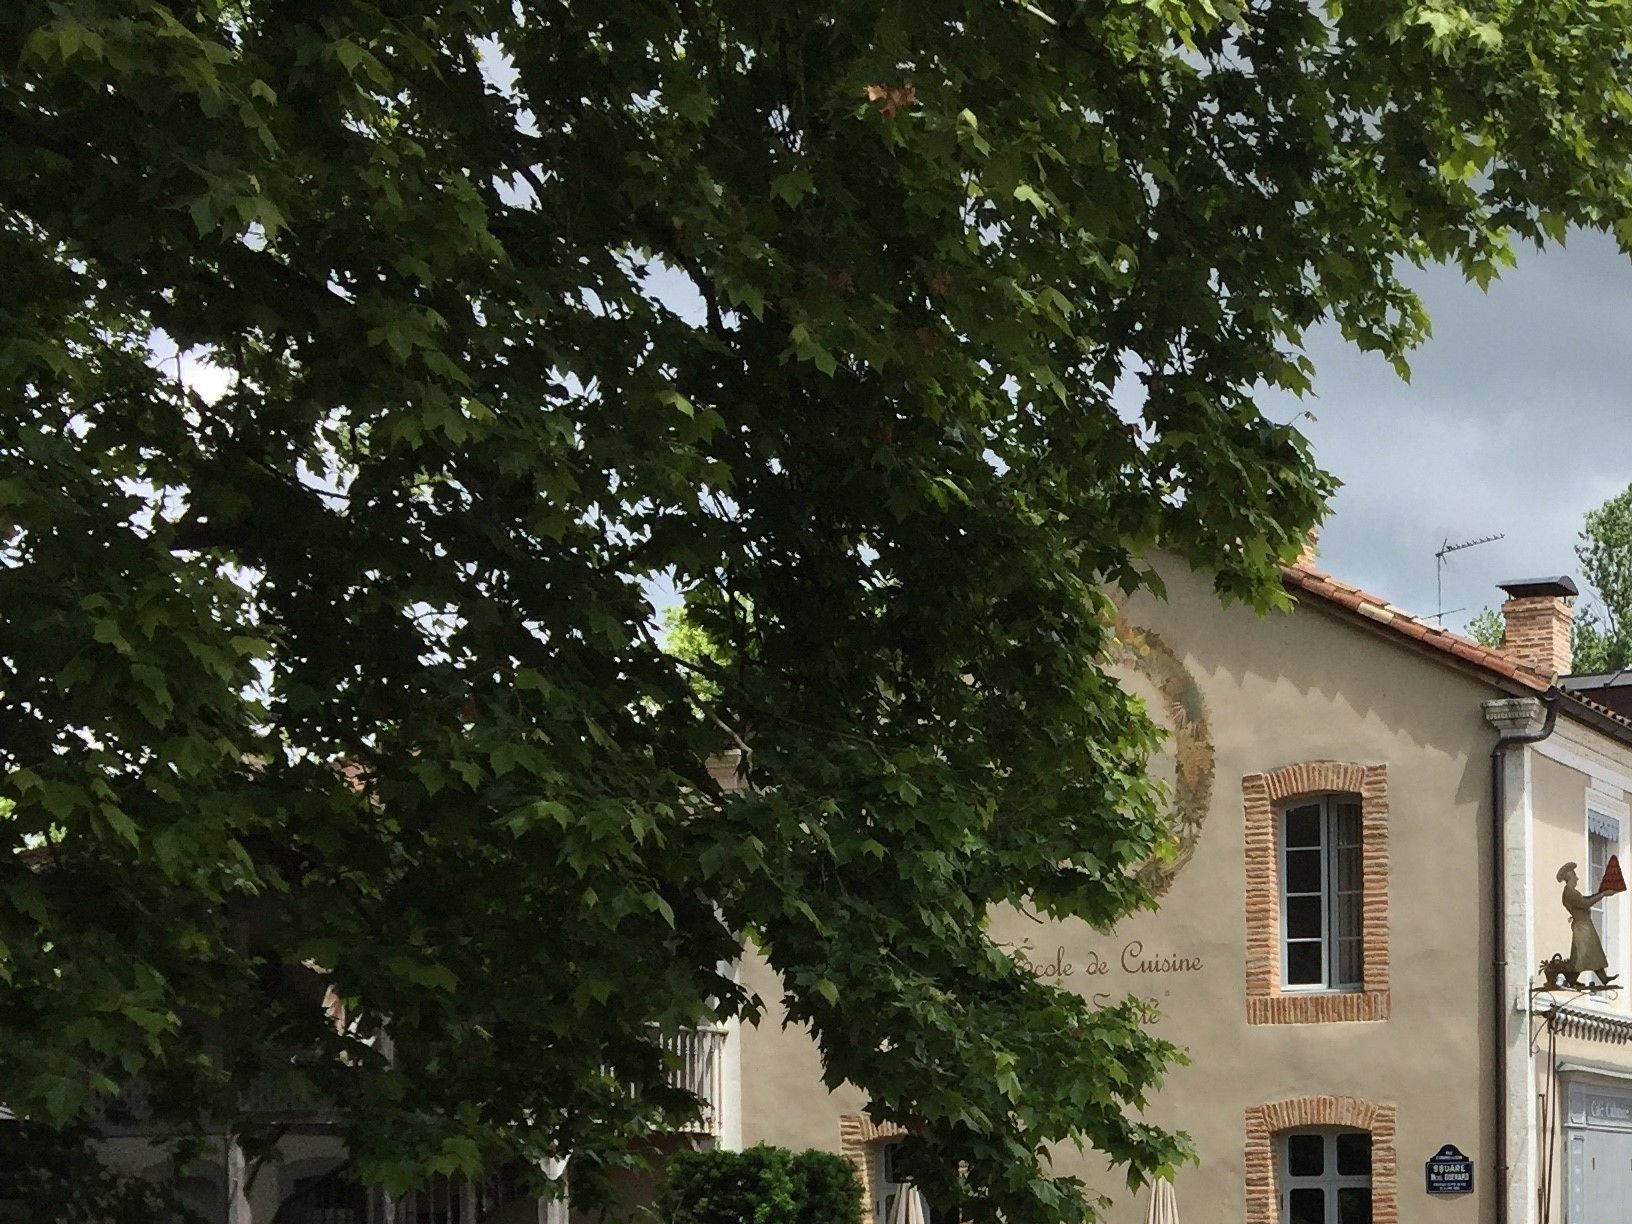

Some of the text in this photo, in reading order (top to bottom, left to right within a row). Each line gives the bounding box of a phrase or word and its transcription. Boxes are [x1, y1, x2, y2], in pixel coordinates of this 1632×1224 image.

[1085, 951, 1111, 976] de
[1121, 940, 1203, 974] Cuisine
[1433, 1164, 1466, 1173] SQUARE
